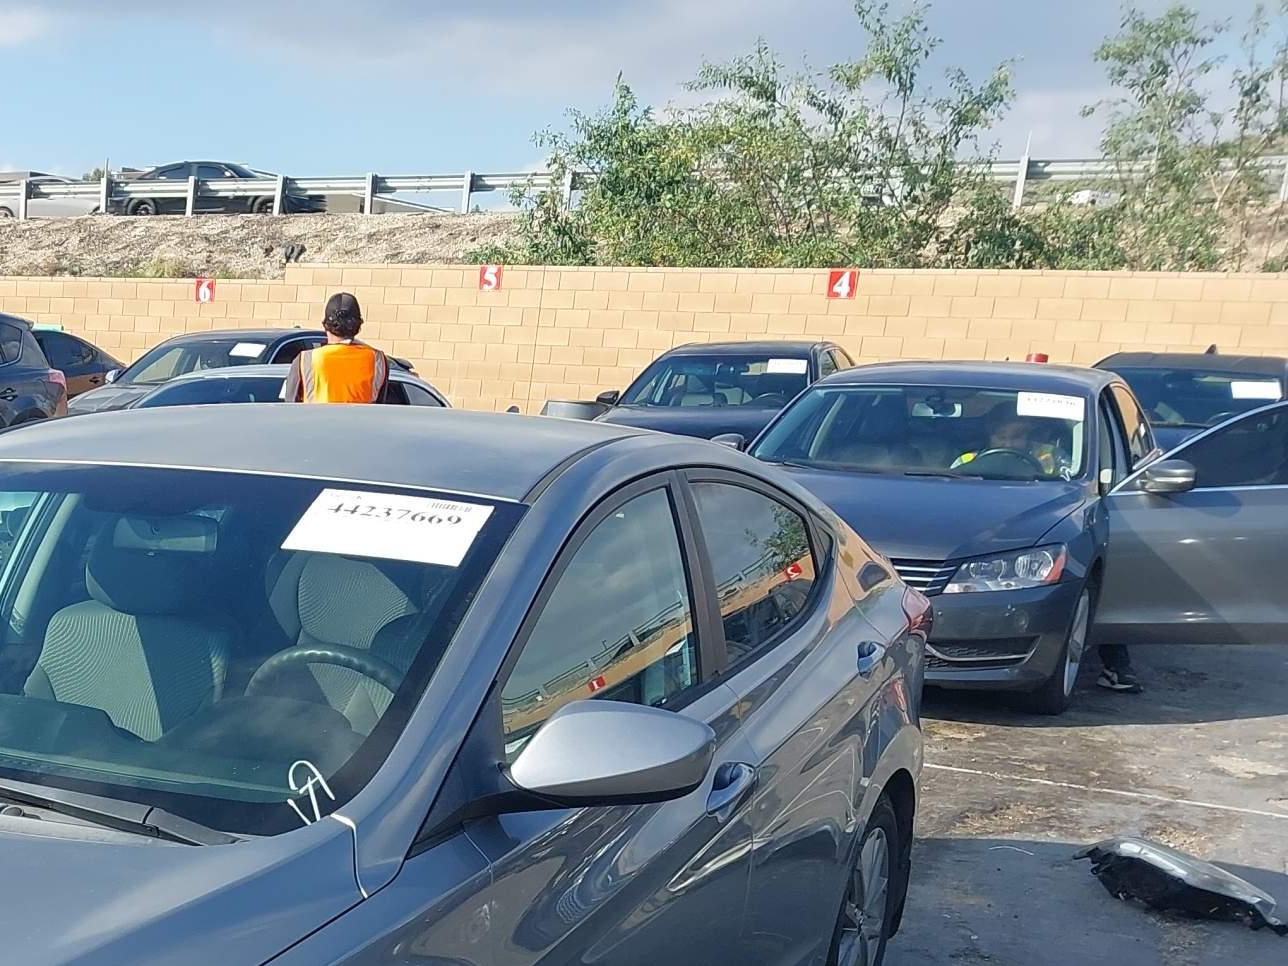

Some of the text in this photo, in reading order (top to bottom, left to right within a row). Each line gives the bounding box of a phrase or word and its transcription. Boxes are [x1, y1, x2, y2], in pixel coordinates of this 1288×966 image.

[482, 265, 498, 290] 5
[832, 271, 851, 298] 4
[198, 280, 212, 303] 6
[328, 503, 462, 525] 44237669
